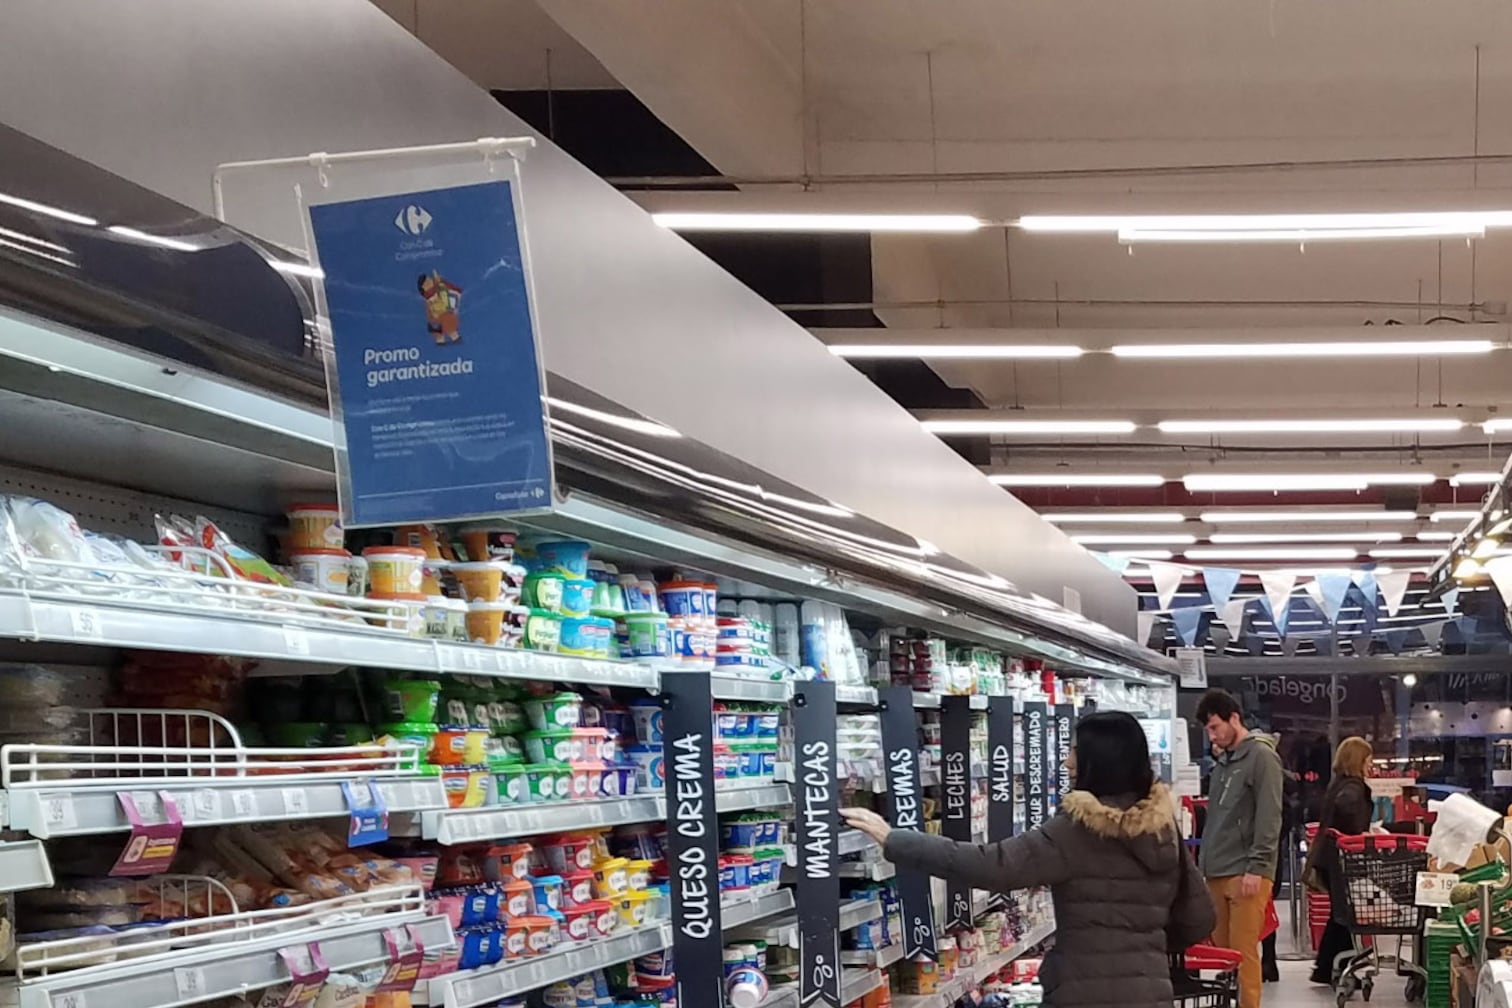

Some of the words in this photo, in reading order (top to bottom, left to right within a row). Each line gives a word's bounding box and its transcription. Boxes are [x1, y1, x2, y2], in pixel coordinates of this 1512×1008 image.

[364, 347, 420, 365] Promo
[367, 357, 474, 387] garantizada
[673, 733, 705, 838] CREMA
[889, 748, 918, 832] REMAS
[946, 751, 966, 819] LECHES
[992, 744, 1010, 803] SALUD
[1029, 710, 1042, 795] DESCREMADO
[803, 740, 832, 879] MANTECAS
[680, 846, 713, 939] QUESO
